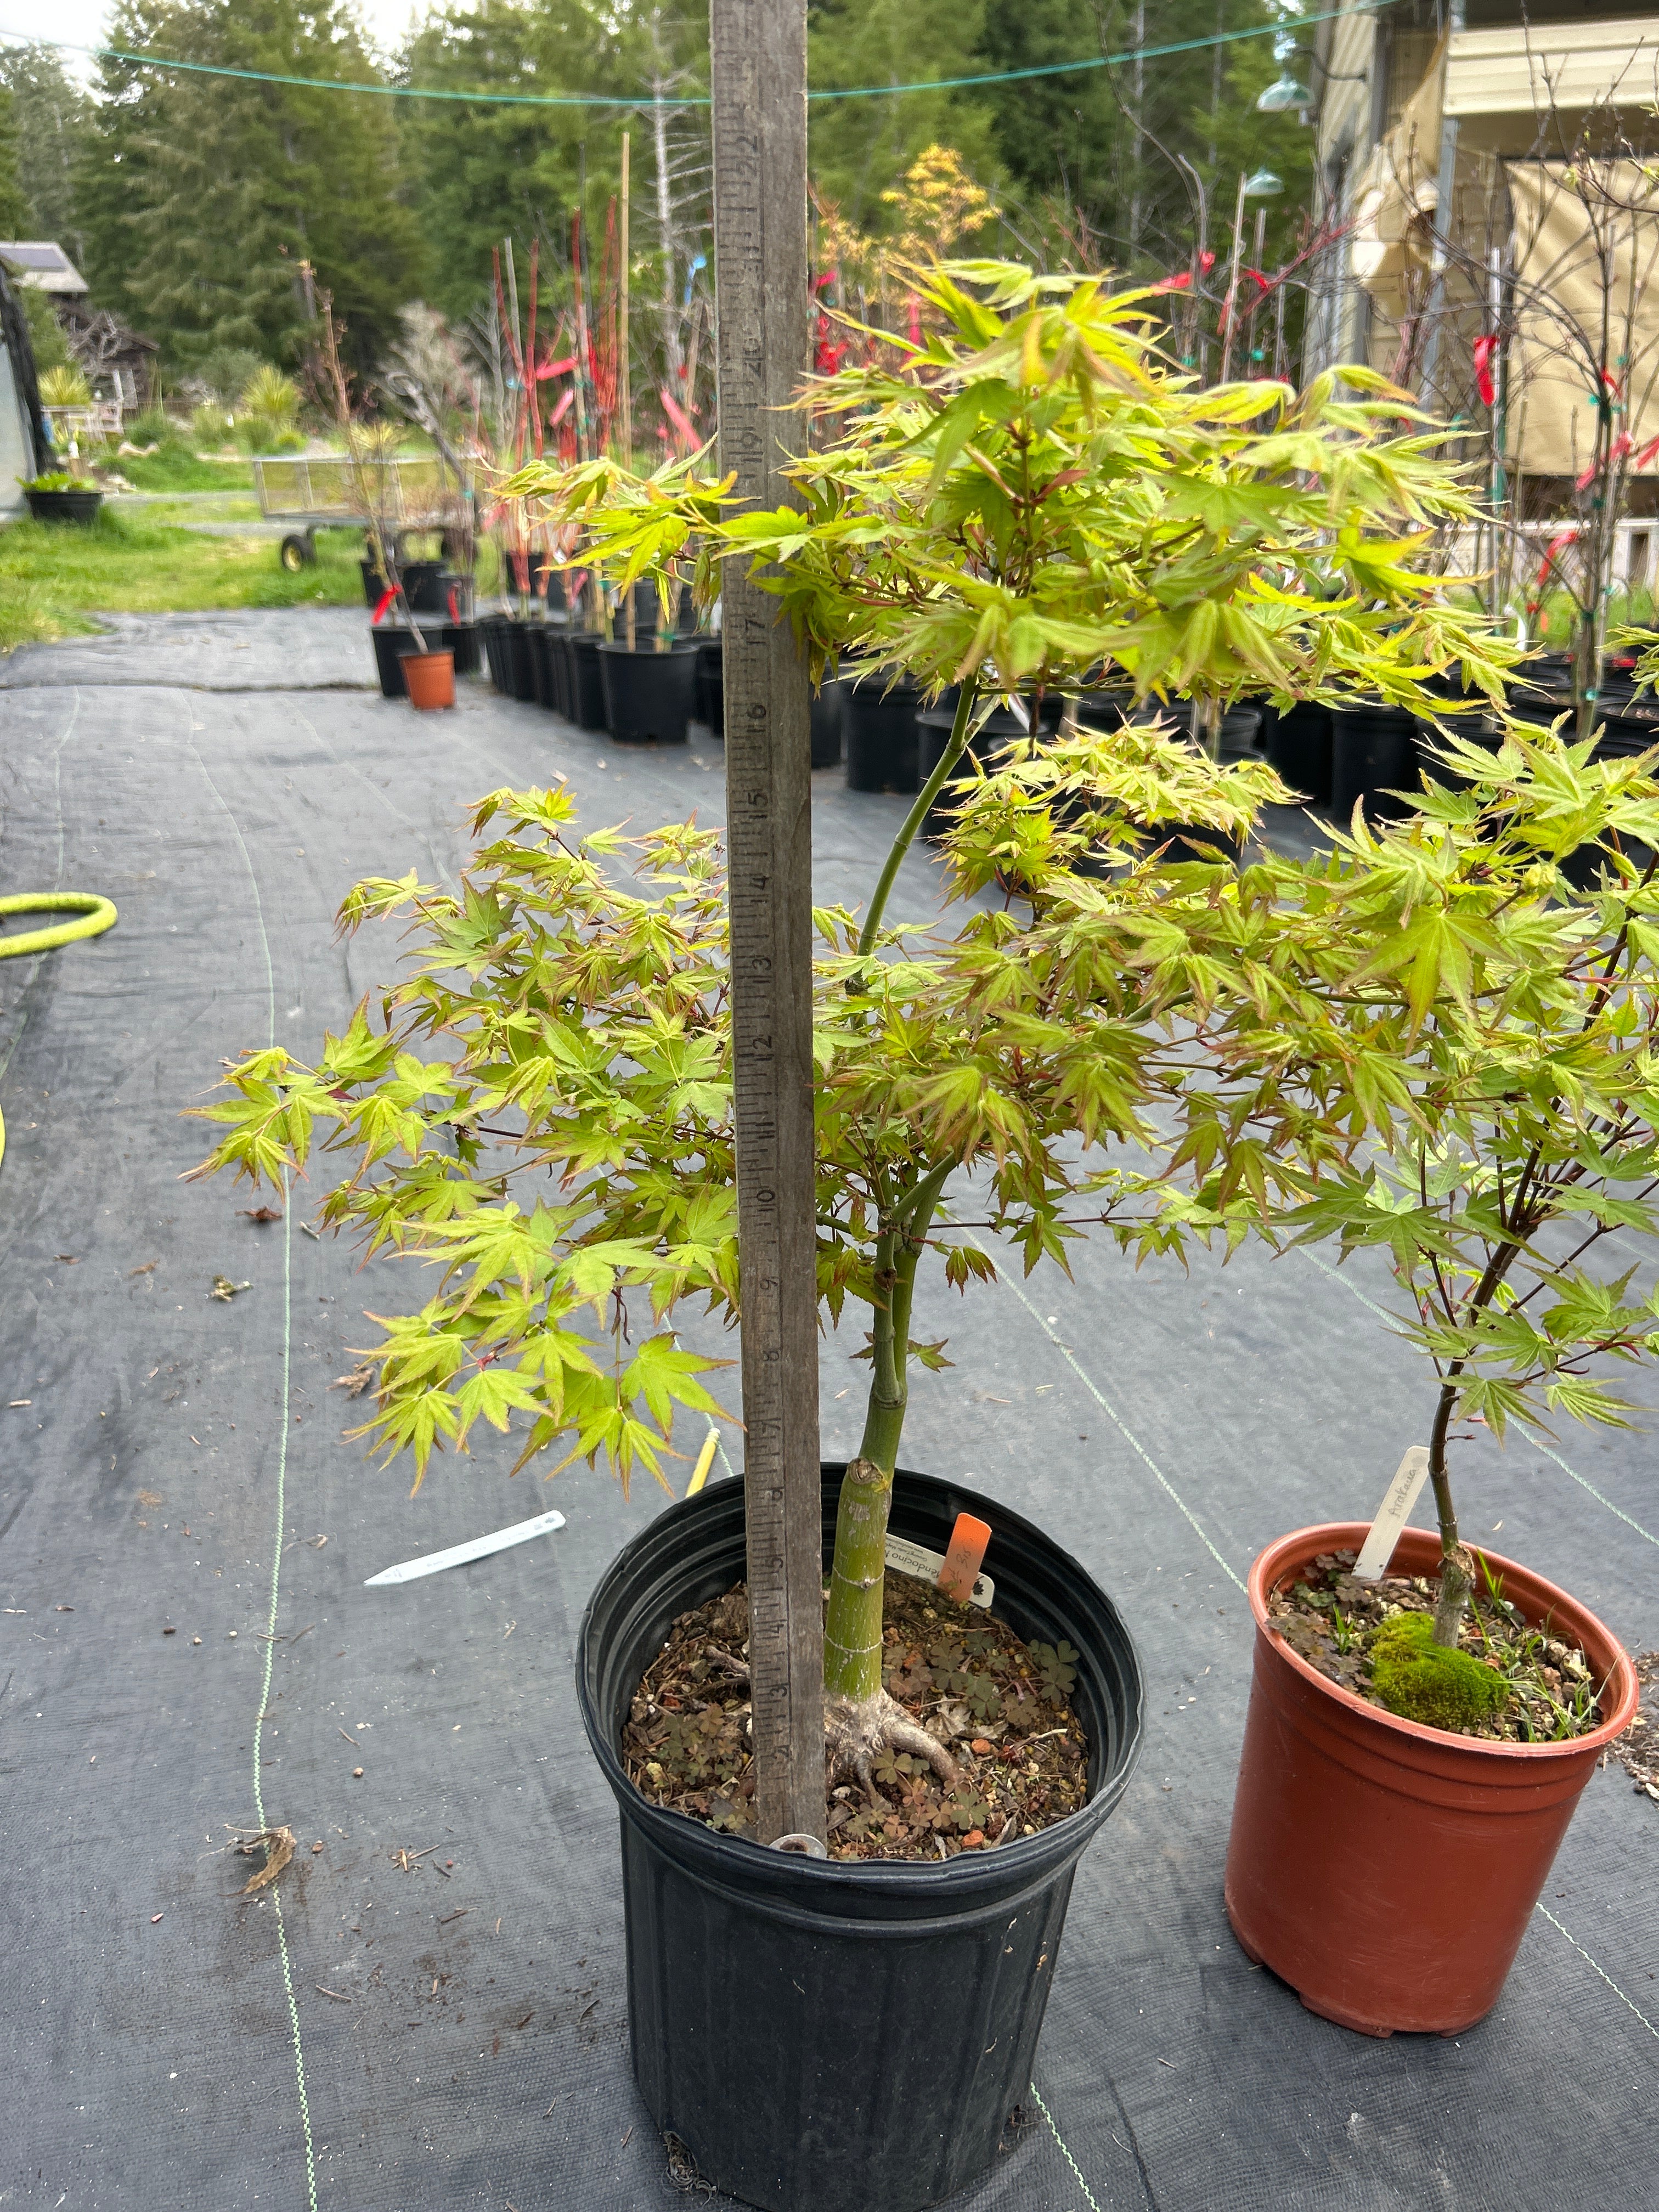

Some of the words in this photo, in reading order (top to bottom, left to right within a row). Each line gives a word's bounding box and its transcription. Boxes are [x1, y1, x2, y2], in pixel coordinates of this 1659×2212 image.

[745, 618, 766, 646] 17
[747, 704, 767, 734] 16
[748, 792, 768, 819] 15
[748, 876, 769, 903] 14
[752, 957, 771, 983] 13
[752, 1036, 773, 1062] 12
[757, 1189, 776, 1212] 10
[760, 1279, 778, 1290] 9
[763, 1351, 780, 1362] 8
[762, 1420, 781, 1434] 7
[765, 1558, 784, 1568] 5
[763, 1623, 785, 1634] 4
[769, 1684, 787, 1697] 3
